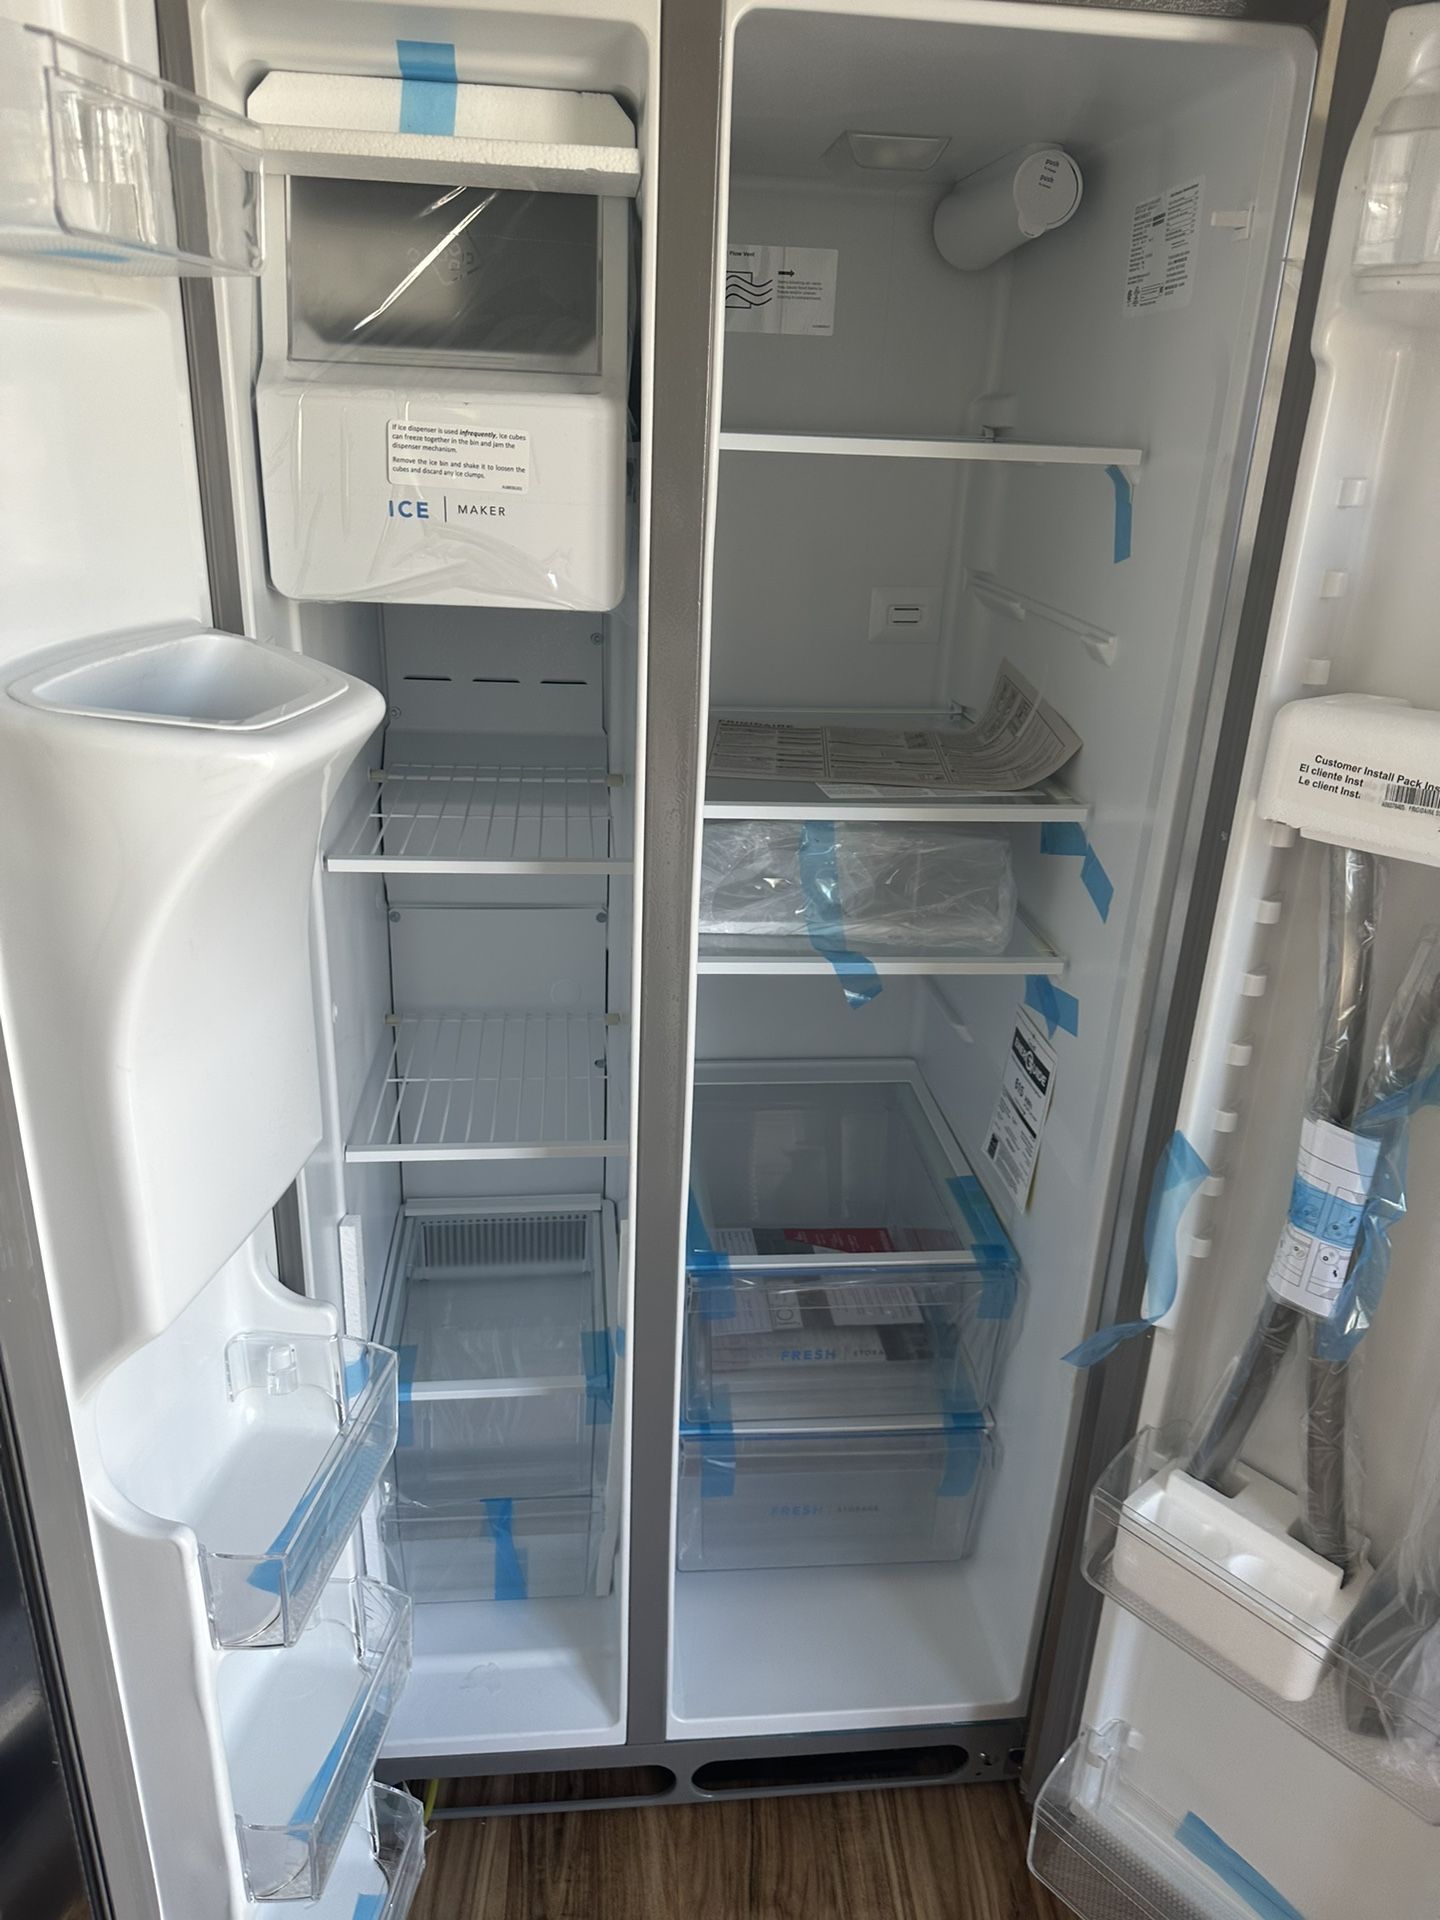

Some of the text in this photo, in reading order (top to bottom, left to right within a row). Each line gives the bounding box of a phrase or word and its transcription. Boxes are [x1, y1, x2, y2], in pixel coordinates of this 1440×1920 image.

[404, 433, 424, 441] freeze
[424, 435, 450, 444] together
[458, 437, 469, 445] the
[469, 438, 480, 446] bin
[492, 441, 504, 449] jam
[407, 425, 437, 434] dispenser
[508, 433, 526, 441] cubes
[392, 442, 458, 453] dispenser mechanism.
[392, 456, 417, 465] Remove
[417, 458, 428, 466] the
[495, 464, 515, 473] loosen
[392, 465, 410, 473] cubes
[410, 466, 422, 474] and
[422, 467, 443, 475] discard
[464, 471, 485, 480] clumps.
[388, 500, 506, 519] ICE MAKER
[1300, 763, 1309, 773] El
[1311, 768, 1342, 781] cliente
[1315, 754, 1362, 773] Customer
[1364, 767, 1395, 782] Install
[1396, 774, 1422, 789] Pack
[1298, 776, 1310, 786] Le
[1312, 780, 1338, 794] client
[780, 1350, 836, 1360] FRESH
